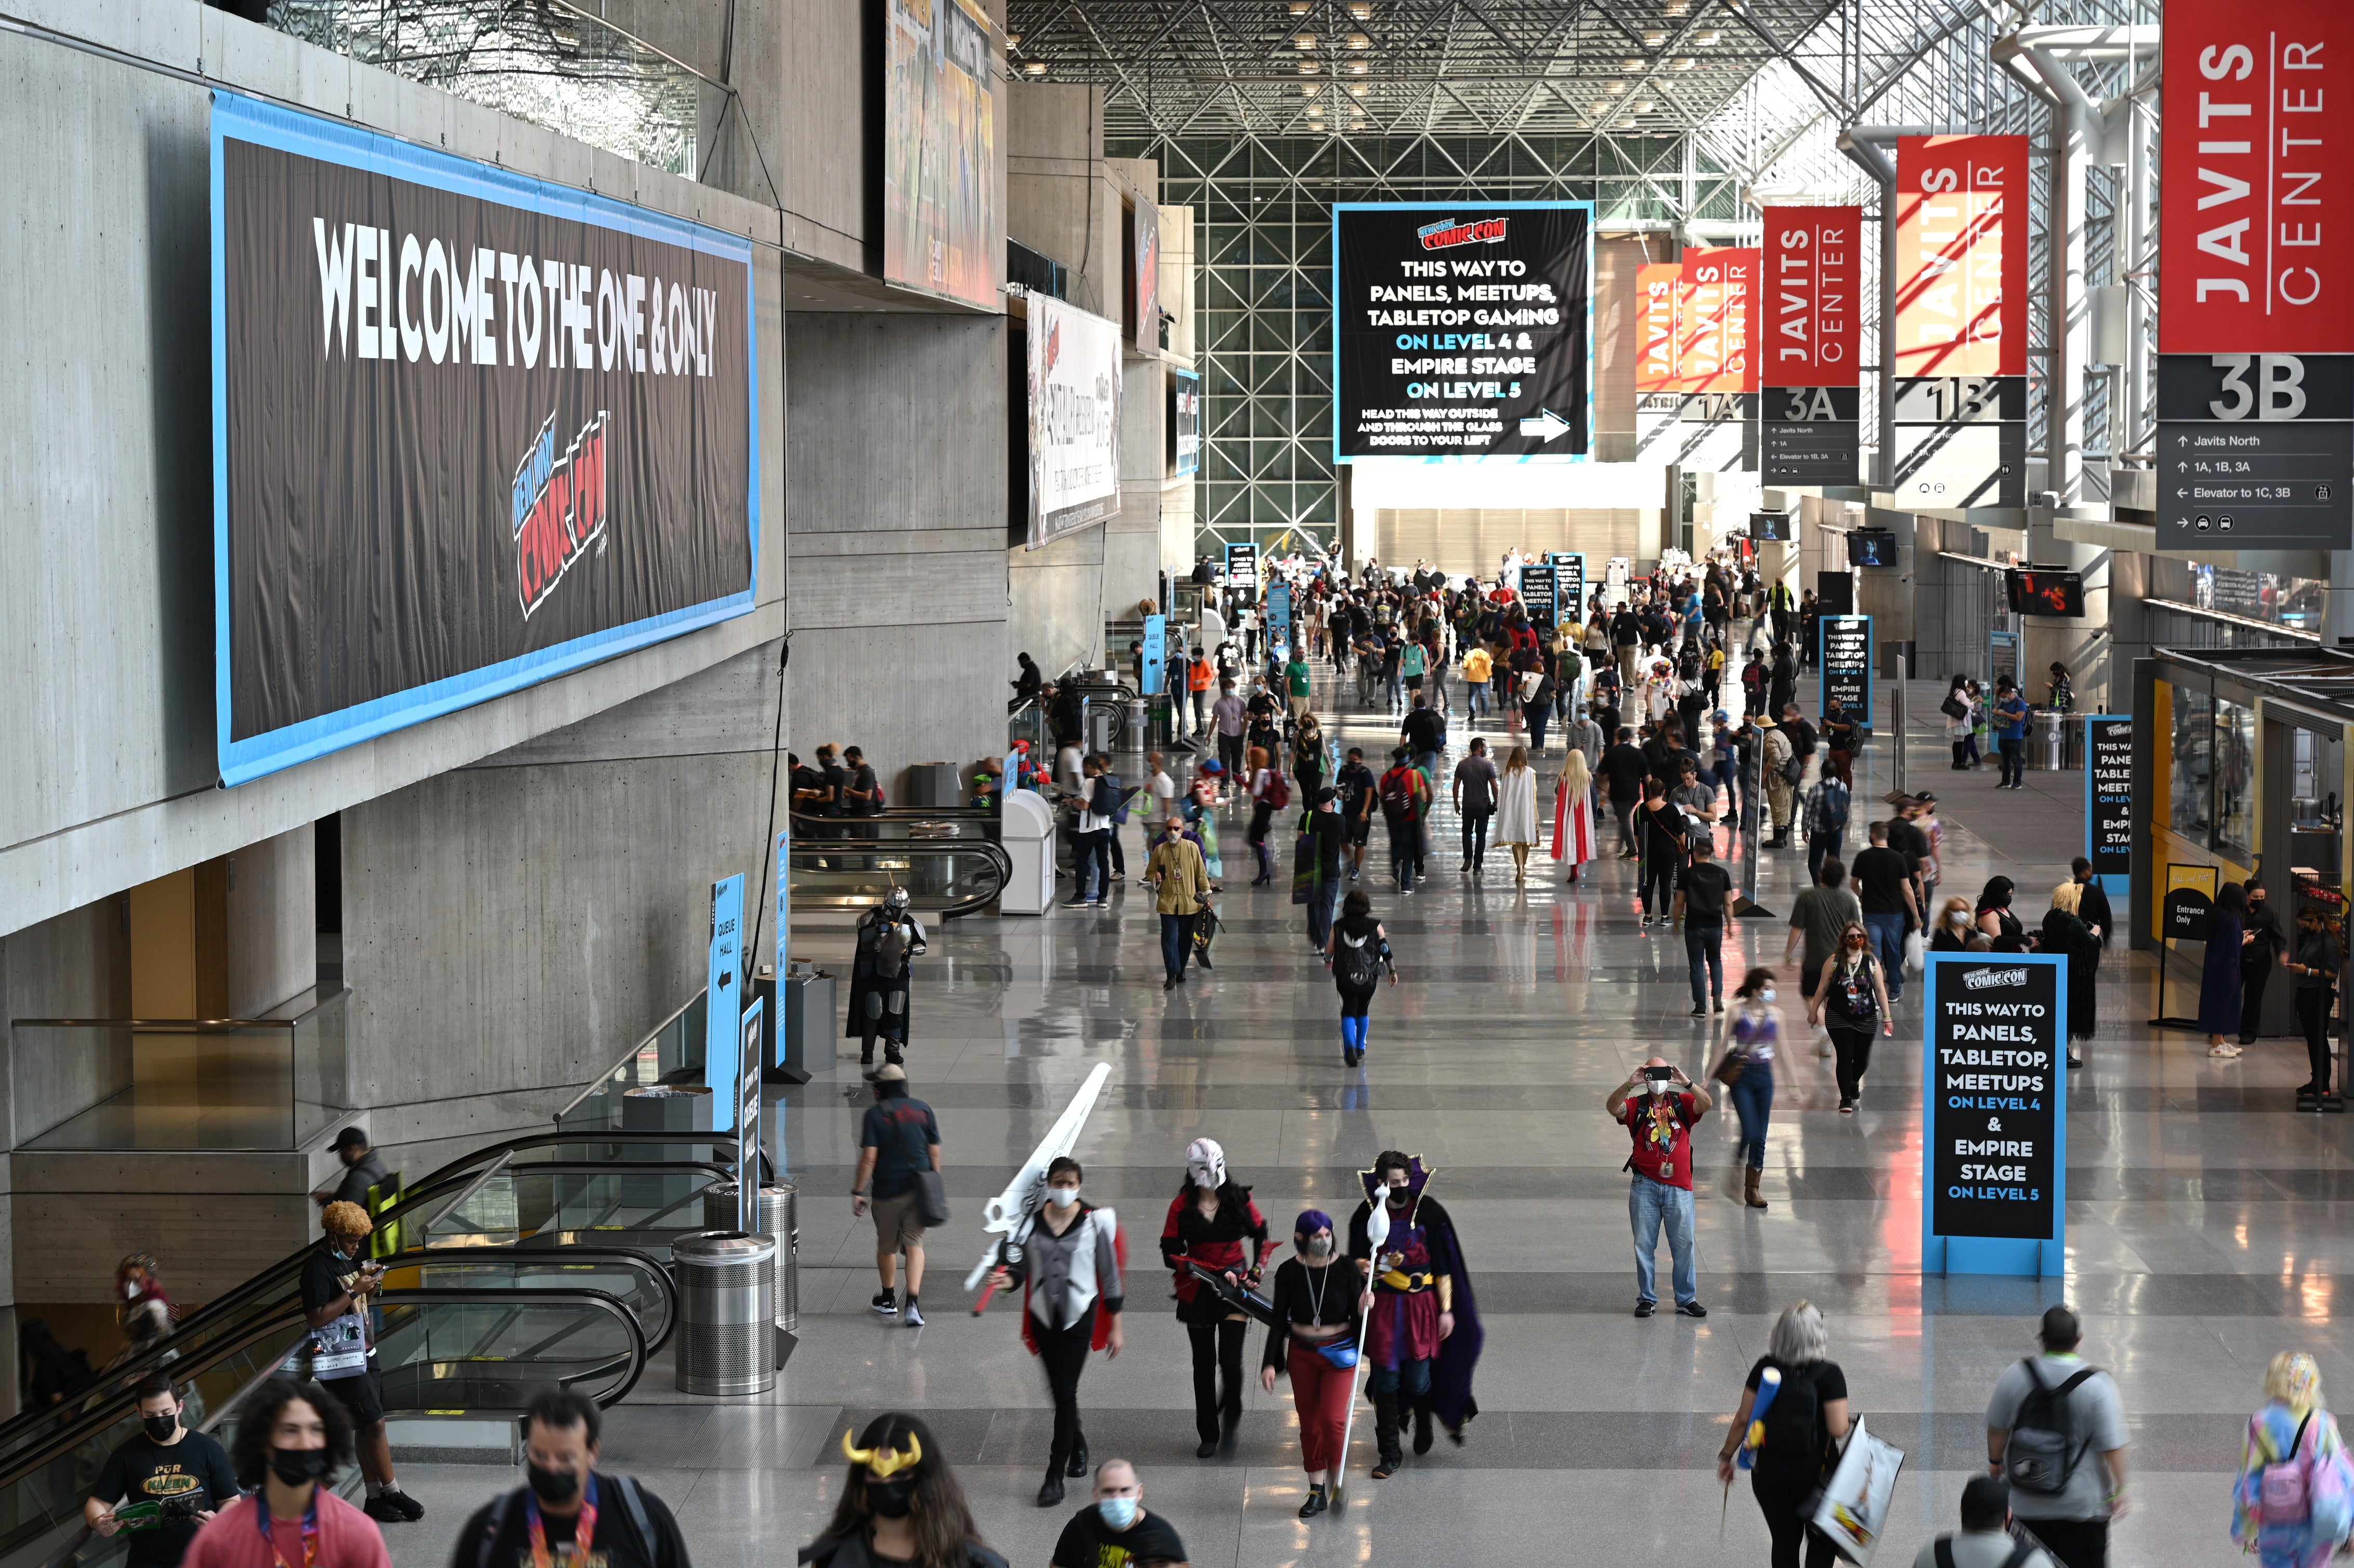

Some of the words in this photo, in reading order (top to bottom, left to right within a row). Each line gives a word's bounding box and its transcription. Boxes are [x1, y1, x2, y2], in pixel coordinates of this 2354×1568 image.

[2196, 44, 2253, 303] JAVITS
[2279, 41, 2323, 305] CENTER
[1419, 226, 1434, 236] NEW
[1435, 220, 1454, 231] YORK
[1424, 225, 1472, 248] COMIC
[1474, 219, 1504, 240] CON
[1920, 168, 1957, 342] JAVITS
[1975, 165, 2004, 344] CENTER
[1401, 261, 1446, 277] THIS
[1451, 261, 1496, 276] WAY
[1496, 260, 1526, 276] TO
[313, 217, 495, 365] WELCOME
[500, 253, 542, 369] TO
[544, 261, 593, 369] THE
[597, 268, 646, 375] ONE
[651, 277, 666, 375] &
[668, 279, 716, 377] ONLY
[1370, 285, 1452, 304] PANELS,
[1457, 284, 1557, 303] MEETUPS,
[1781, 230, 1808, 361] JAVITS
[1822, 229, 1844, 362] CENTER
[1368, 310, 1470, 326] TABLETOP
[1474, 308, 1559, 325] GAMING
[1695, 266, 1719, 373] JAVITS
[1729, 265, 1747, 374] CENTER
[1648, 281, 1669, 374] JAVITS
[1396, 334, 1428, 350] ON
[1433, 334, 1495, 350] LEVEL
[1498, 333, 1512, 349] 4
[1516, 333, 1533, 349] &
[1392, 358, 1468, 374] EMPIRE
[1472, 357, 1536, 374] STAGE
[1407, 383, 1438, 398] ON
[1444, 382, 1506, 398] LEVEL
[1508, 382, 1521, 398] 5
[2209, 355, 2306, 420] 3B
[1643, 397, 1681, 408] ATRIU
[1700, 393, 1740, 420] 1A
[1784, 387, 1837, 421] 3A
[1930, 377, 1991, 421] 1B
[1362, 409, 1394, 419] HEAD
[1395, 409, 1421, 419] THIS
[1422, 409, 1448, 419] WAY
[1448, 408, 1498, 419] OUTSIDE
[1357, 422, 1383, 432] AND
[1384, 422, 1441, 433] THROUGH
[1441, 422, 1464, 432] THE
[1466, 422, 1503, 432] GLASS
[1370, 436, 1411, 446] DOORS
[1412, 435, 1429, 445] TO
[1429, 435, 1462, 445] YOUR
[1464, 435, 1491, 445] LEFT
[2194, 436, 2226, 447] Javits
[2229, 436, 2260, 446] North
[514, 459, 533, 528] NEW
[533, 422, 555, 492] YORK
[2194, 461, 2212, 474] 1A,
[2215, 461, 2232, 474] 1B,
[2235, 461, 2251, 472] 3A
[2194, 488, 2238, 499] Elevator
[2240, 488, 2252, 499] to
[2255, 488, 2272, 500] 1C,
[2275, 488, 2291, 498] 3B
[522, 472, 571, 604] COMIC
[575, 425, 604, 539] CON
[2109, 726, 2129, 736] COMIC
[2101, 755, 2131, 765] PANE
[2095, 769, 2131, 778] TABLE
[2098, 783, 2131, 793] MEET
[2121, 806, 2129, 815] &
[2103, 820, 2130, 829] EMPI
[2107, 834, 2130, 843] STA
[2177, 905, 2204, 914] Entrance
[718, 919, 735, 936] QUEUE
[2177, 915, 2190, 925] Only
[720, 940, 732, 957] HALL
[1968, 973, 2001, 988] COMIC
[2004, 970, 2025, 983] CON
[1946, 1002, 1982, 1016] THIS
[1985, 1003, 2020, 1016] WAY
[2022, 1004, 2045, 1017] TO
[1953, 1024, 2037, 1044] PANELS,
[1940, 1049, 2049, 1069] TABLETOP,
[745, 1070, 754, 1093] DOWN
[754, 1065, 758, 1081] TO
[1947, 1074, 2044, 1091] MEETUPS
[744, 1093, 758, 1129] QUEUE
[1948, 1096, 1974, 1109] ON
[1978, 1097, 2027, 1110] LEVEL
[2030, 1098, 2041, 1110] 4
[1987, 1117, 2002, 1132] &
[745, 1132, 755, 1164] HALL
[1955, 1140, 2033, 1157] EMPIRE
[1960, 1165, 2026, 1182] STAGE
[1948, 1186, 1974, 1199] ON
[1978, 1186, 2027, 1200] LEVEL
[2030, 1188, 2039, 1201] 5
[148, 1478, 191, 1491] KLEEN
